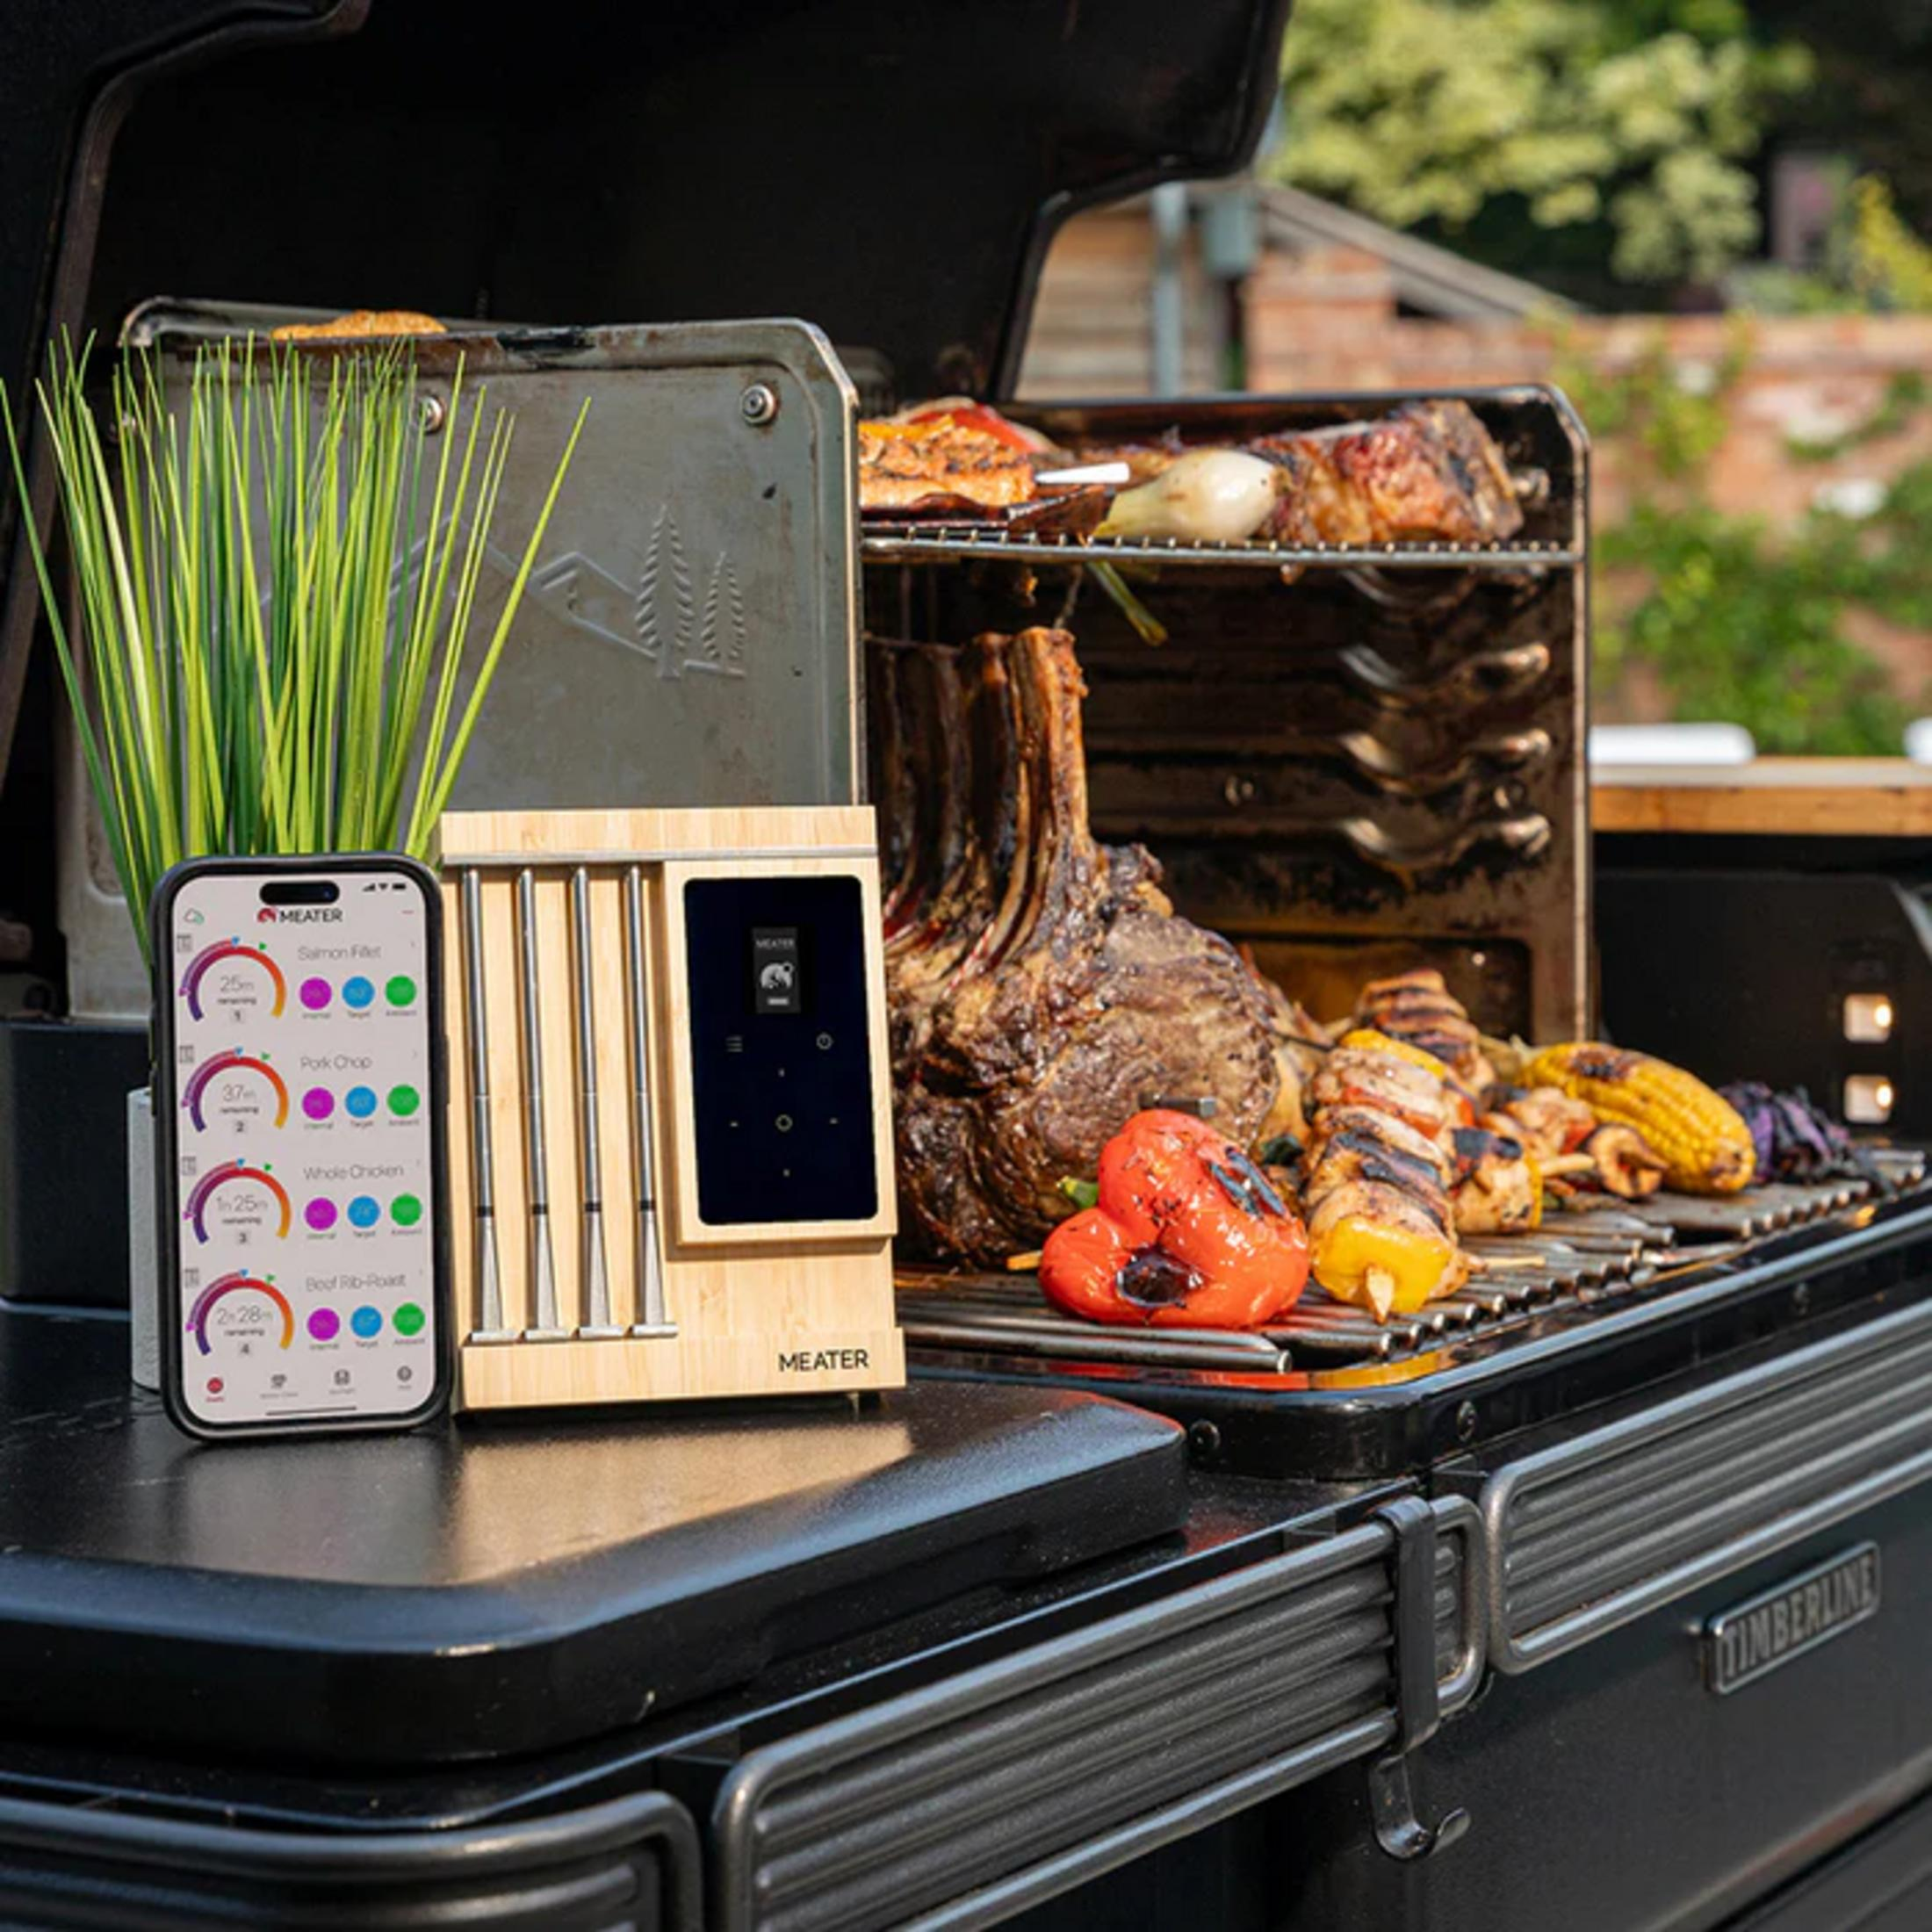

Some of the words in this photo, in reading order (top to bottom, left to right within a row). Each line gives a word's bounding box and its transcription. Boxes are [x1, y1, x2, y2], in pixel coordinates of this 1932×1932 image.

[279, 908, 342, 922] MEATER
[298, 946, 348, 961] Salmon
[300, 1056, 332, 1071] Pork
[334, 1054, 372, 1071] Chop
[303, 1165, 347, 1180] Whole
[350, 1164, 404, 1179] Chicken
[306, 1275, 336, 1293] Beef
[778, 1349, 869, 1372] MEATER
[1723, 1552, 1873, 1677] TIMBERLINE
